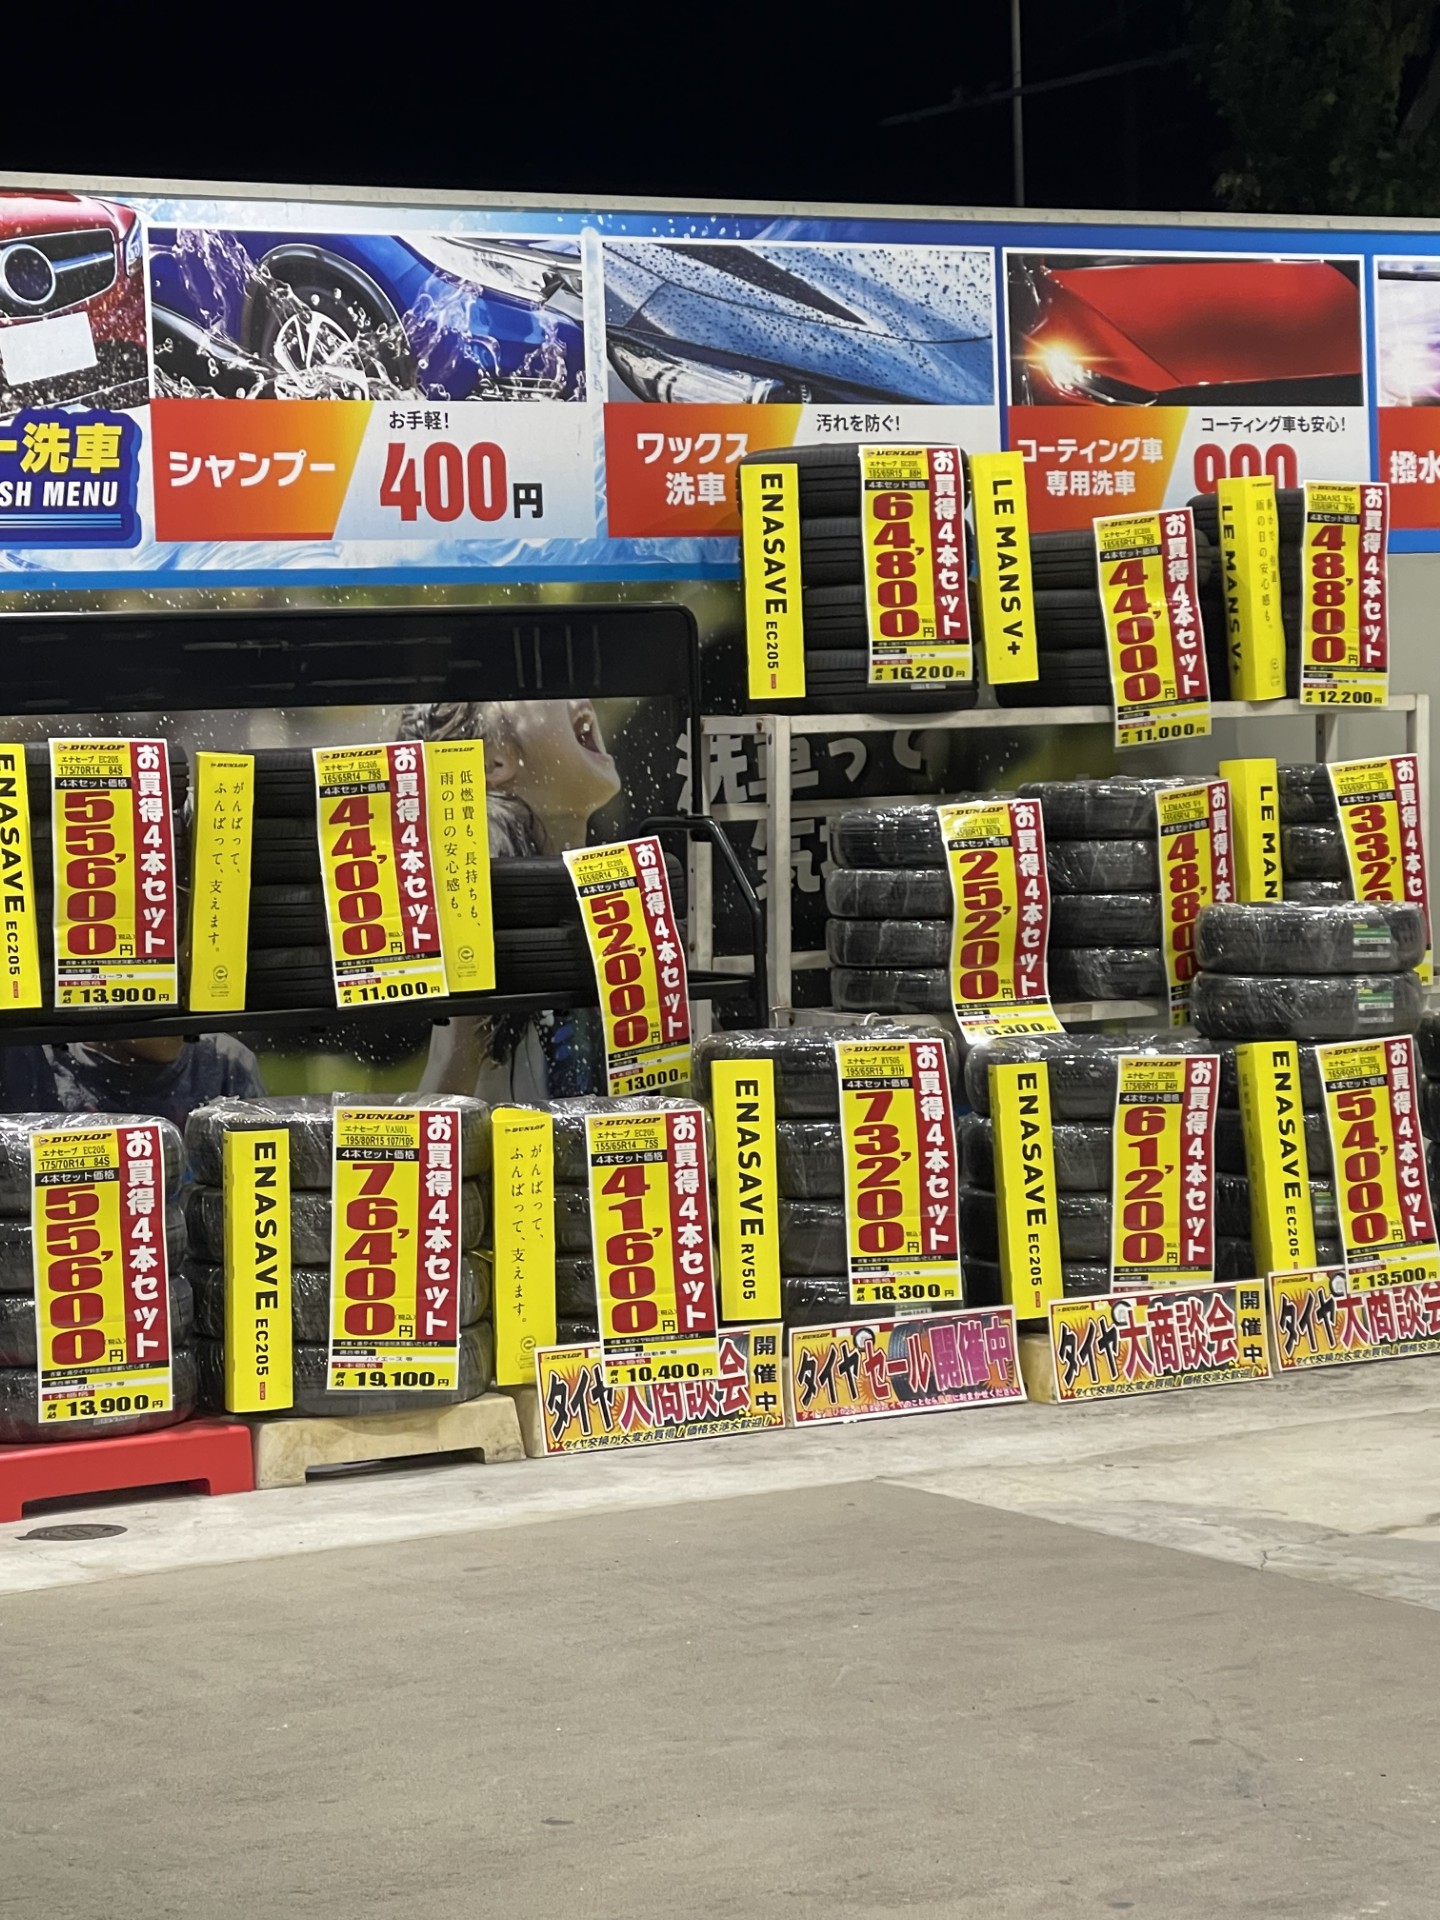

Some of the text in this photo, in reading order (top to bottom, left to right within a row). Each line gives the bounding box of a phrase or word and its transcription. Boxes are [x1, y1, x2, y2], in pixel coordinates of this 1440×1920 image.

[389, 411, 449, 430] お手軽!
[816, 414, 900, 433] 汚れを防ぐ!
[1200, 416, 1345, 433] コーティング車も安心!
[636, 433, 749, 464] ワックス
[1017, 438, 1163, 463] コーティング車
[169, 448, 336, 488] シャンプー
[665, 472, 727, 505] 洗車
[868, 481, 926, 489] 4本セット価格
[1046, 469, 1136, 496] 専用洗車
[42, 481, 118, 507] MENU
[992, 479, 1015, 515] LE
[1310, 514, 1358, 523] 4本セット価格
[932, 450, 961, 636] お買得4本セット
[1103, 546, 1159, 560] 4本セット価格
[761, 473, 787, 669] ENASAVE EC205
[872, 491, 925, 638] 64,800
[995, 526, 1022, 613] MANS
[1362, 487, 1384, 665] お買得4本セット
[1311, 524, 1353, 663] 48,800
[1165, 513, 1200, 695] お買得4本セット
[923, 626, 935, 638] 円
[1109, 558, 1161, 702] 44,000
[1348, 654, 1358, 665] 円
[1165, 687, 1176, 698] 円
[69, 743, 125, 751] DUNLOP
[331, 749, 382, 760] DUNLOP
[61, 755, 119, 763] エナセーブ EC205
[324, 762, 354, 771] エナセーブ
[59, 766, 123, 775] 175/70R14 84S
[322, 773, 361, 784] 165/65R14
[59, 778, 128, 789] 4本セット価格
[323, 782, 386, 796] 4本セット価格
[1260, 785, 1275, 822] LE
[1342, 791, 1394, 804] 4本セット価格
[956, 807, 1003, 815] DUNLOP
[136, 744, 167, 955] お買得4本セット
[394, 747, 431, 950] お買得4本セット
[440, 771, 462, 918] 雨の日の安心感も。
[460, 769, 481, 927] 低燃費も、長持ちも、
[581, 848, 625, 861] DUNLOP
[64, 790, 127, 956] 55,600
[328, 795, 387, 956] 44,000
[578, 863, 603, 873] エナセーブ
[582, 879, 636, 895] 4本セット価格
[1013, 805, 1043, 997] お買得4本セット
[959, 850, 1012, 1000] 25,200
[5, 921, 21, 976] EC205
[390, 941, 403, 953] 円
[634, 843, 684, 1039] お買得4本セット
[119, 944, 134, 956] 円
[589, 891, 649, 1049] 52,000
[1002, 987, 1013, 998] 円
[650, 1030, 661, 1043] 円
[1334, 1045, 1380, 1055] DUNLOP
[847, 1057, 877, 1065] エナセーブ
[846, 1067, 884, 1075] 195/65R15
[846, 1078, 910, 1088] 4本セット価格
[1330, 1077, 1385, 1089] 4本セット価格
[1123, 1093, 1180, 1102] 4本セット価格
[354, 1113, 415, 1121] DUNLOP
[605, 1116, 661, 1126] DUNLOP
[344, 1124, 408, 1133] エナセーブ VAN01
[512, 1124, 545, 1133] DUNLOP
[596, 1128, 655, 1139] エナセーブ EC205
[51, 1132, 113, 1144] DUNLOP
[345, 1135, 414, 1146] 195/80R15 107/105
[595, 1139, 659, 1151] 155/65R14 75S
[1390, 1042, 1427, 1237] お買得4本セット
[42, 1145, 106, 1157] エナセーブ EC205
[341, 1148, 415, 1160] 4本セット価格
[916, 1045, 949, 1251] お買得4本セット
[1272, 1050, 1301, 1256] ENASAVE EC205
[40, 1156, 110, 1170] 175/70R14 84S
[595, 1151, 664, 1164] 4本セット価格
[1185, 1061, 1212, 1262] お買得4本セット
[853, 1091, 911, 1254] 73,200
[1336, 1089, 1389, 1244] 54,000
[40, 1169, 115, 1184] 4本セット価格
[1017, 1072, 1047, 1285] ENASAVE EC205
[1122, 1105, 1174, 1264] 61,200
[735, 1079, 764, 1300] ENASAVE RV505
[424, 1114, 452, 1336] お買得4本セット
[673, 1115, 707, 1328] お買得4本セット
[1392, 1228, 1403, 1240] 円
[125, 1130, 159, 1359] お買得4本セット
[344, 1162, 410, 1336] 76,400
[601, 1165, 664, 1334] 41,600
[907, 1241, 919, 1253] 円
[254, 1141, 278, 1375] ENASAVE EC205
[1166, 1251, 1178, 1264] 円
[45, 1184, 114, 1366] 55,600
[399, 1324, 413, 1338] 円
[662, 1319, 676, 1332] 円
[1240, 1290, 1263, 1363] 開催中
[1058, 1294, 1238, 1389] タイヤ大商談会
[109, 1348, 124, 1362] 円
[753, 1336, 777, 1412] 開催中
